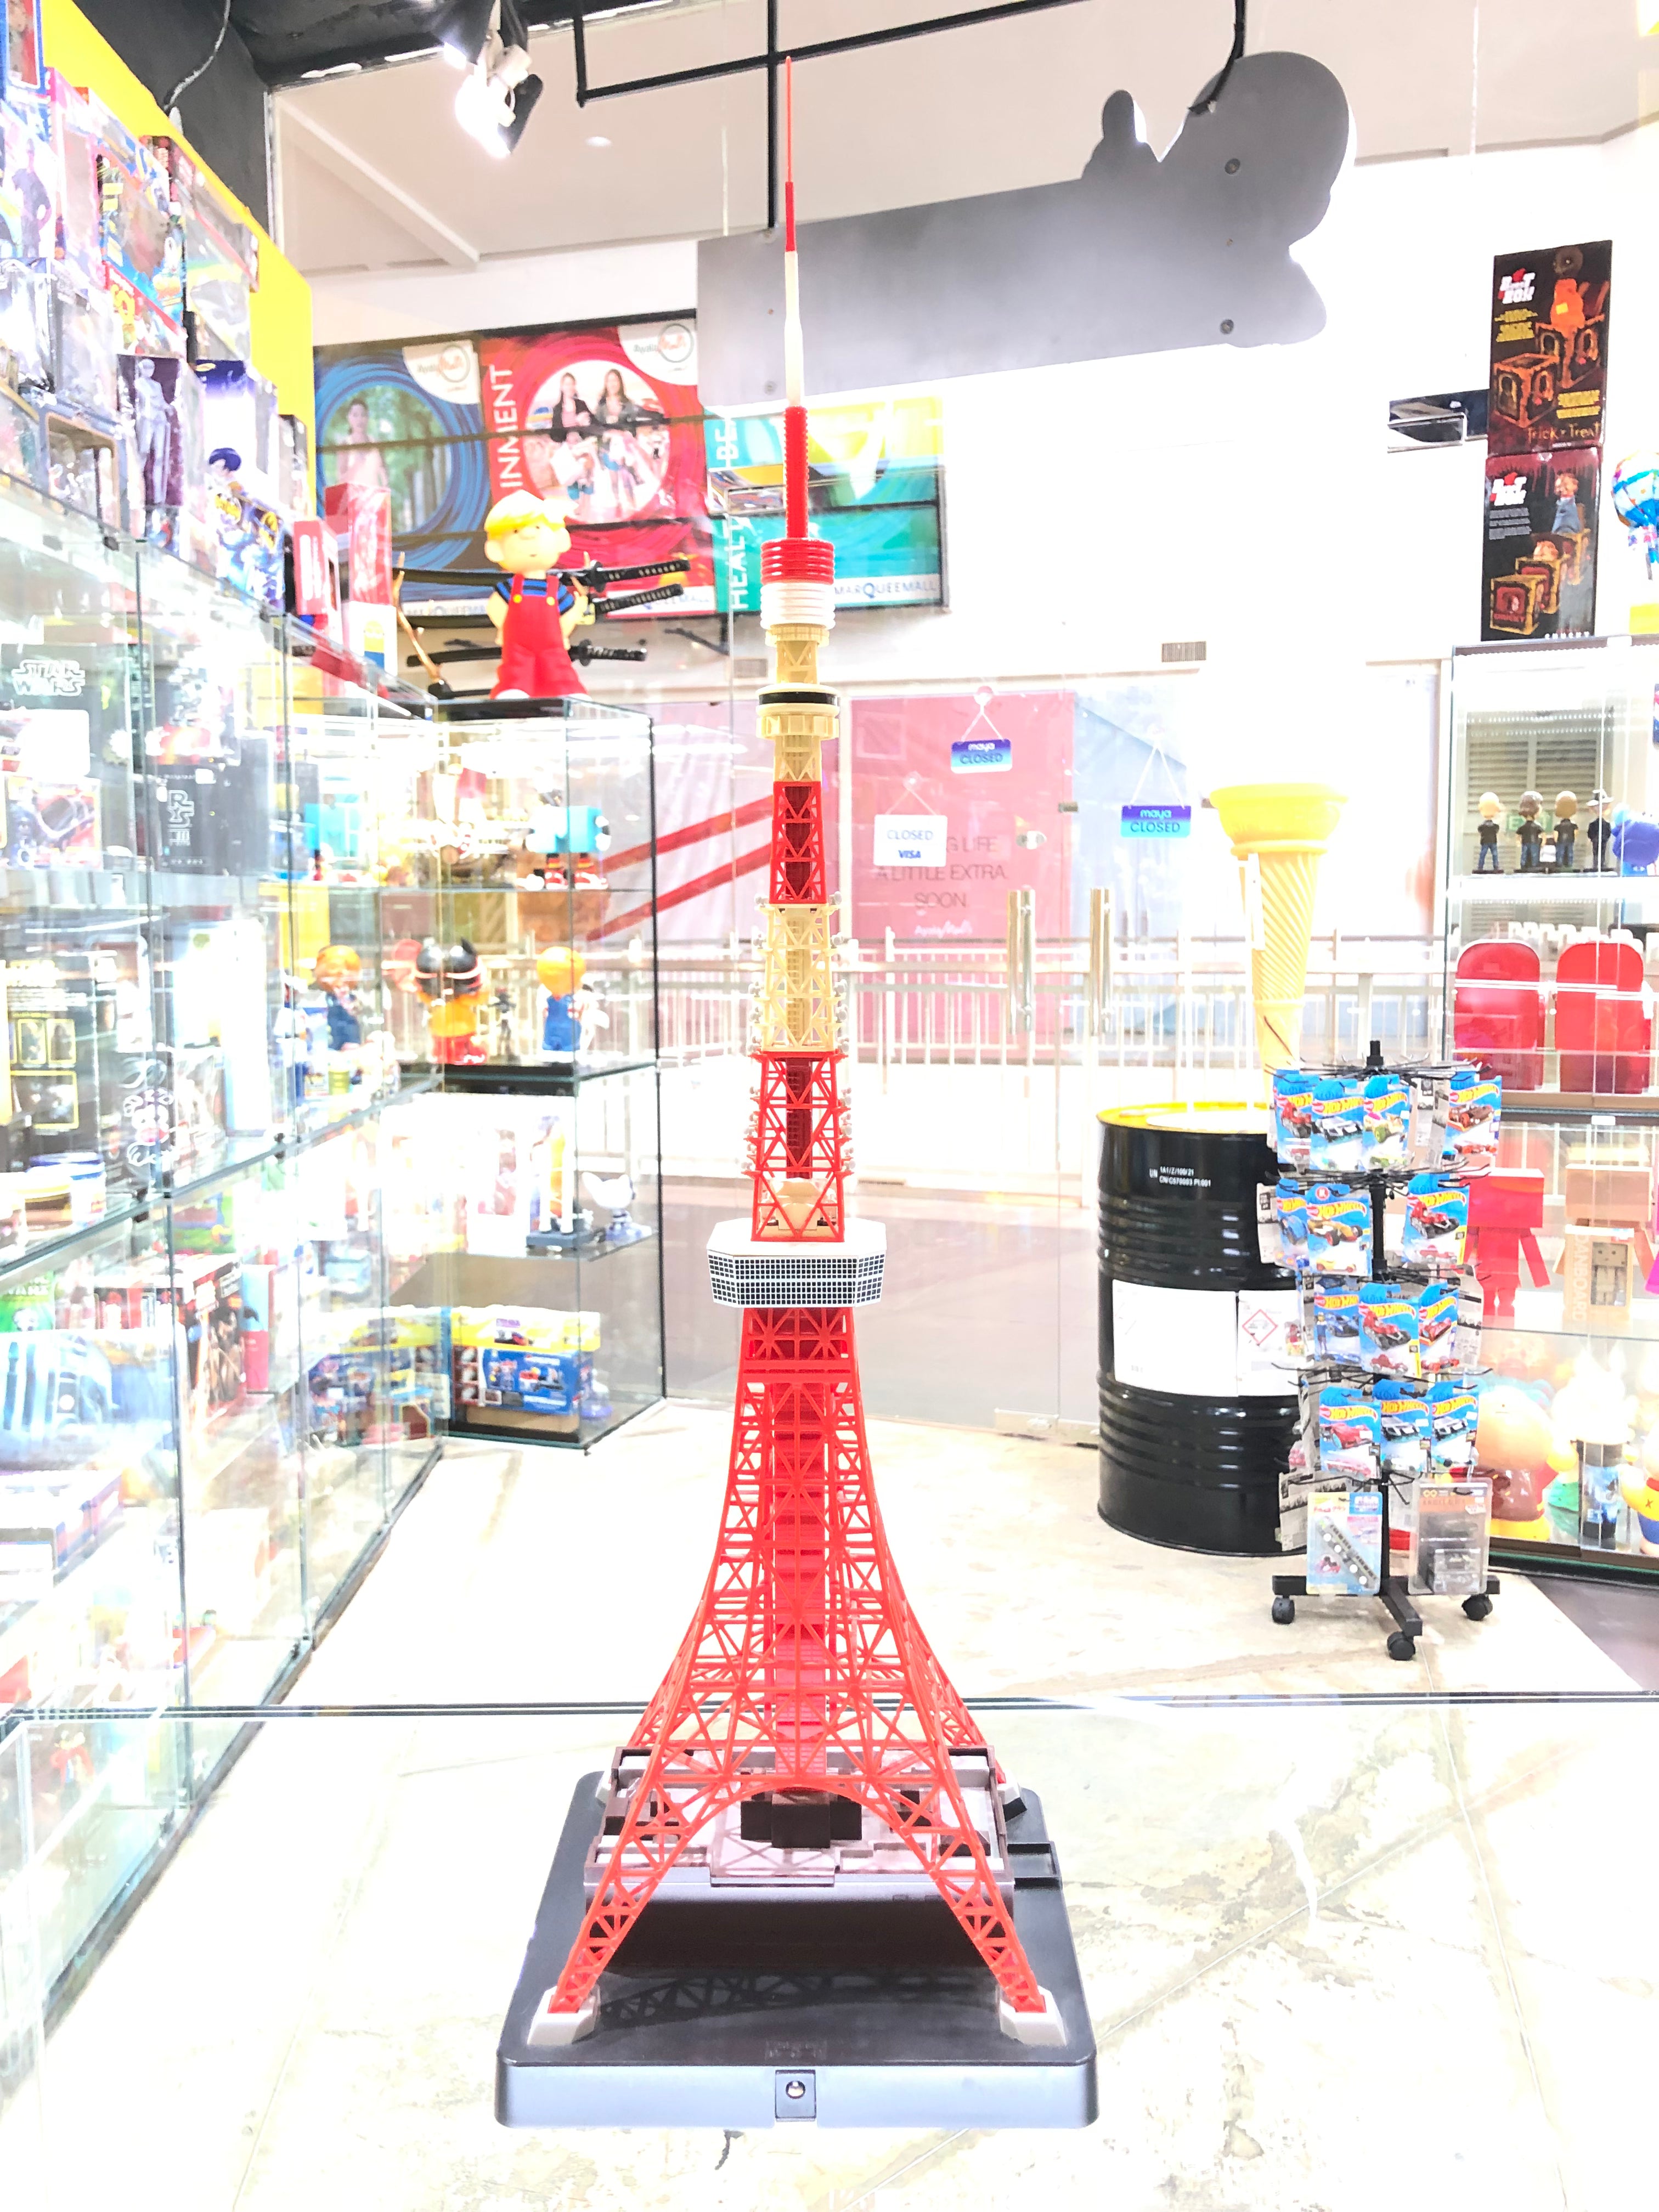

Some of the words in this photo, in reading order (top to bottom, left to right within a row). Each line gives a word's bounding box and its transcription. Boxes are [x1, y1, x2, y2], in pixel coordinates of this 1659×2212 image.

[967, 742, 996, 752] maya
[960, 752, 1004, 765] CLOSED
[1139, 809, 1172, 821] maya
[1130, 822, 1181, 833] CLOSED
[887, 829, 933, 840] CLOSED
[962, 835, 997, 853] LIFE
[898, 850, 921, 859] VISA
[950, 864, 1009, 882] EXTRA
[914, 892, 967, 909] SOON
